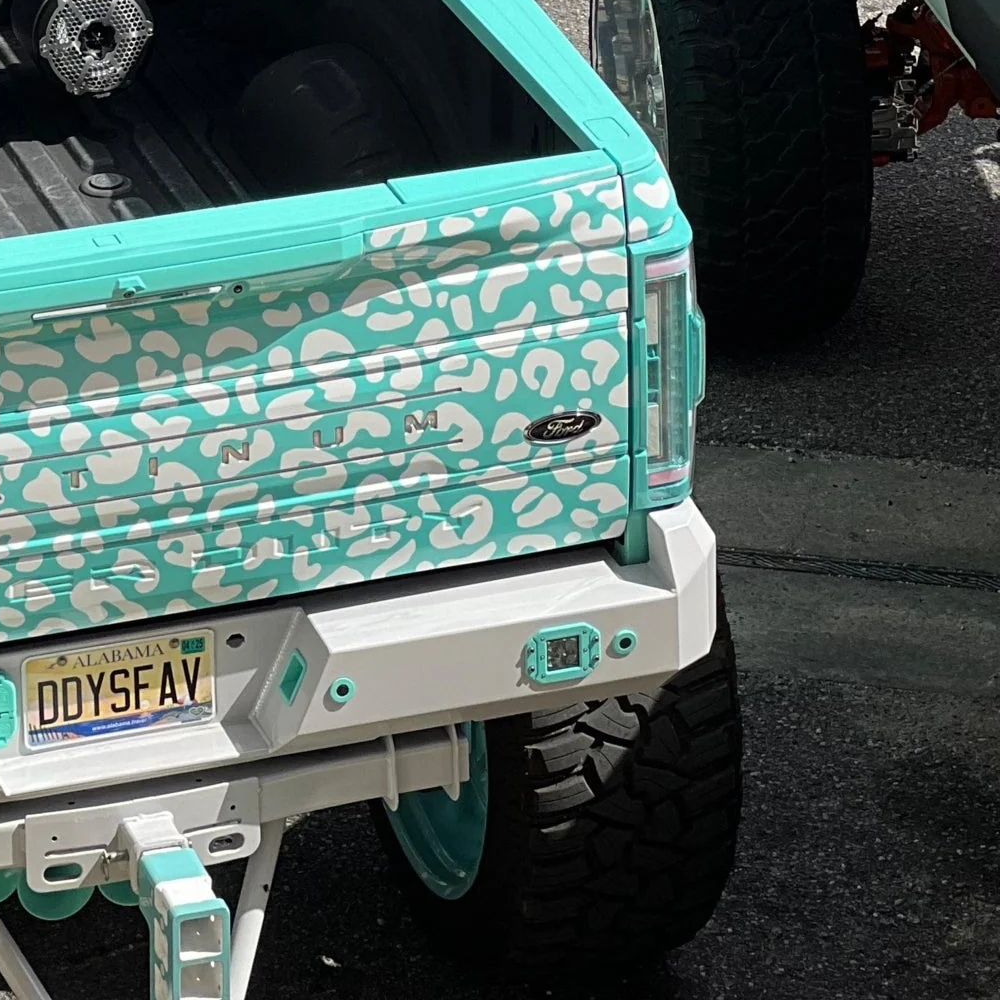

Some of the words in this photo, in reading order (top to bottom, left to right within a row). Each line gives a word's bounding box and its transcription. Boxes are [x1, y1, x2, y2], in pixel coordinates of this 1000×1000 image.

[544, 417, 585, 438] Ford
[72, 643, 164, 670] ALABAMA
[37, 656, 201, 727] DDYSFAV
